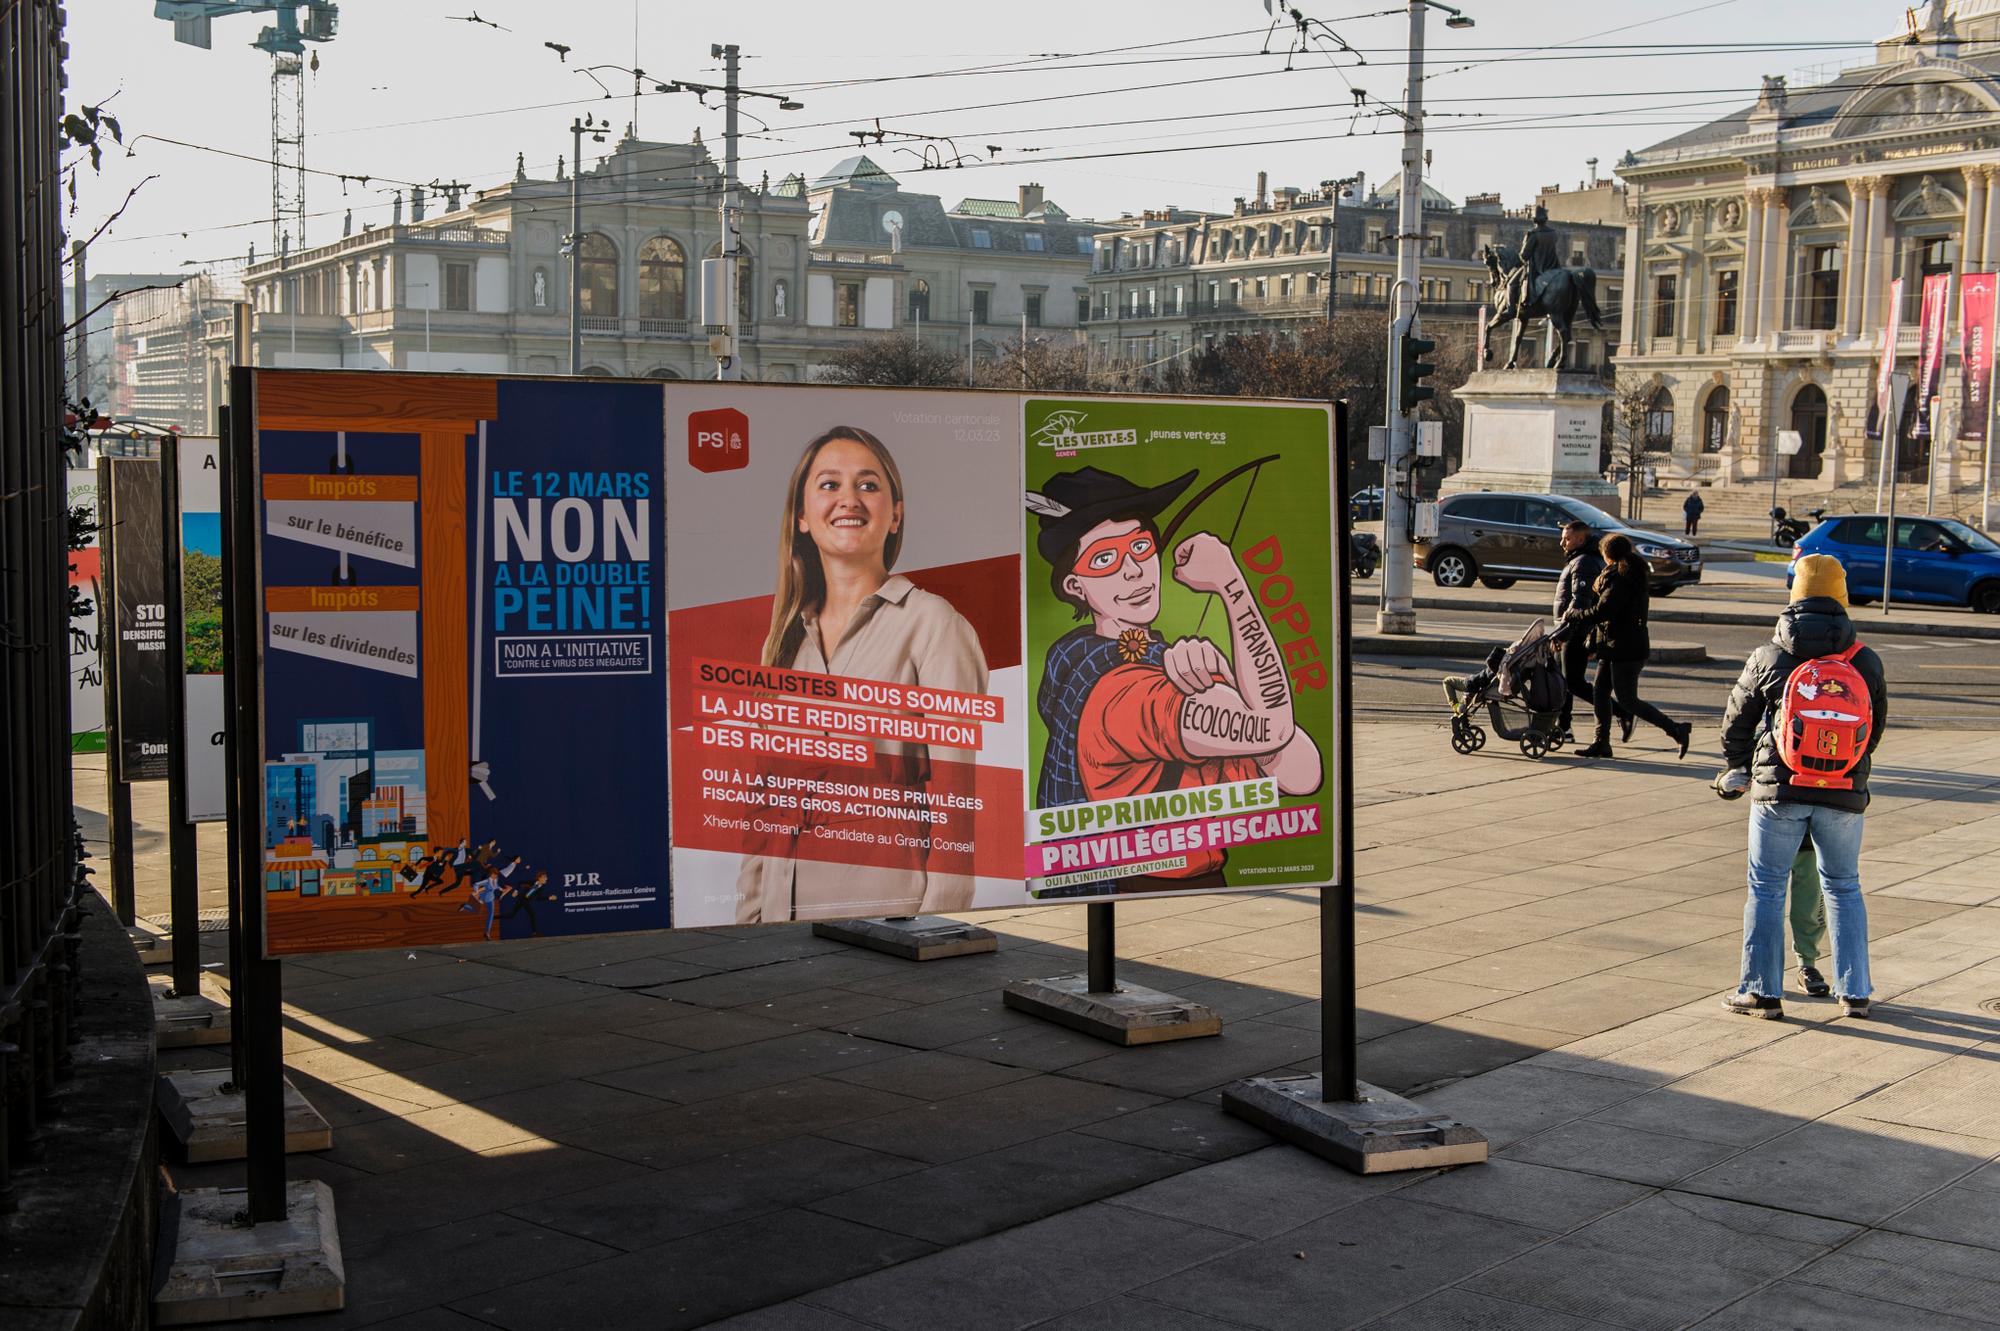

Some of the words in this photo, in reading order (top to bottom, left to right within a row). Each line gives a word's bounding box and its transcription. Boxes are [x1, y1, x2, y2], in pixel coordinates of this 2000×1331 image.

[893, 410, 941, 424] Votation
[944, 413, 1000, 425] cantonale
[698, 432, 724, 448] PS
[954, 430, 1000, 441] 12.03.23
[1056, 434, 1078, 448] LES
[309, 476, 376, 500] Impôts
[494, 471, 524, 497] LE
[532, 472, 560, 497] 12
[569, 472, 650, 497] MARS
[288, 515, 314, 530] sur
[316, 518, 332, 536] le
[336, 522, 404, 552] bénéfice
[494, 497, 650, 562] NON
[494, 564, 512, 586] A
[520, 564, 549, 586] LA
[556, 564, 650, 586] DOUBLE
[136, 604, 165, 620] STO
[311, 587, 378, 610] Impôts
[1241, 534, 1328, 694] DOPER
[272, 623, 298, 639] sur
[302, 626, 326, 646] les
[330, 634, 416, 665] dividendes
[504, 643, 537, 658] NON
[540, 644, 552, 657] A
[556, 642, 641, 657] L'INITIATIVE
[1224, 578, 1244, 604] LA
[1236, 606, 1289, 710] TRANSITION
[541, 660, 550, 668] LE
[552, 659, 576, 668] VIRUS
[578, 659, 594, 667] DES
[700, 664, 837, 698] SOCIALISTES
[842, 682, 901, 706] NOUS
[906, 690, 996, 718] SOMMES
[702, 696, 728, 714] LA
[732, 700, 800, 724] JUSTE
[806, 708, 976, 745] REDISTRIBUTION
[1182, 698, 1271, 743] ÉCOLOGIQUE
[702, 726, 744, 748] DES
[750, 732, 868, 762] RICHESSES
[1818, 728, 1838, 756] 95
[702, 768, 728, 783] OUI
[732, 769, 743, 784] À
[746, 774, 764, 787] LA
[767, 776, 869, 798] SUPPRESSION
[873, 787, 900, 802] DES
[904, 790, 984, 810] PRIVILÈGES
[702, 788, 765, 806] FISCAUX
[769, 794, 797, 808] DES
[800, 798, 841, 813] GROS
[844, 802, 948, 824] ACTIONNAIRES
[1039, 788, 1224, 836] SUPPRIMONS
[1229, 781, 1275, 806] LES
[702, 814, 750, 830] Xhevrie
[754, 818, 798, 836] Osmani
[814, 825, 874, 844] Candidate
[878, 834, 892, 845] au
[895, 834, 930, 849] Grand
[933, 837, 975, 853] Conseil
[1042, 824, 1202, 871] PRIVILÈGES
[1208, 807, 1318, 846] FISCAUX
[564, 873, 601, 887] PLR
[1045, 877, 1063, 888] OUI
[1130, 858, 1185, 876] CANTONALE
[1239, 867, 1267, 875] VOTATION
[1268, 866, 1276, 874] DU
[634, 886, 656, 894] Genève
